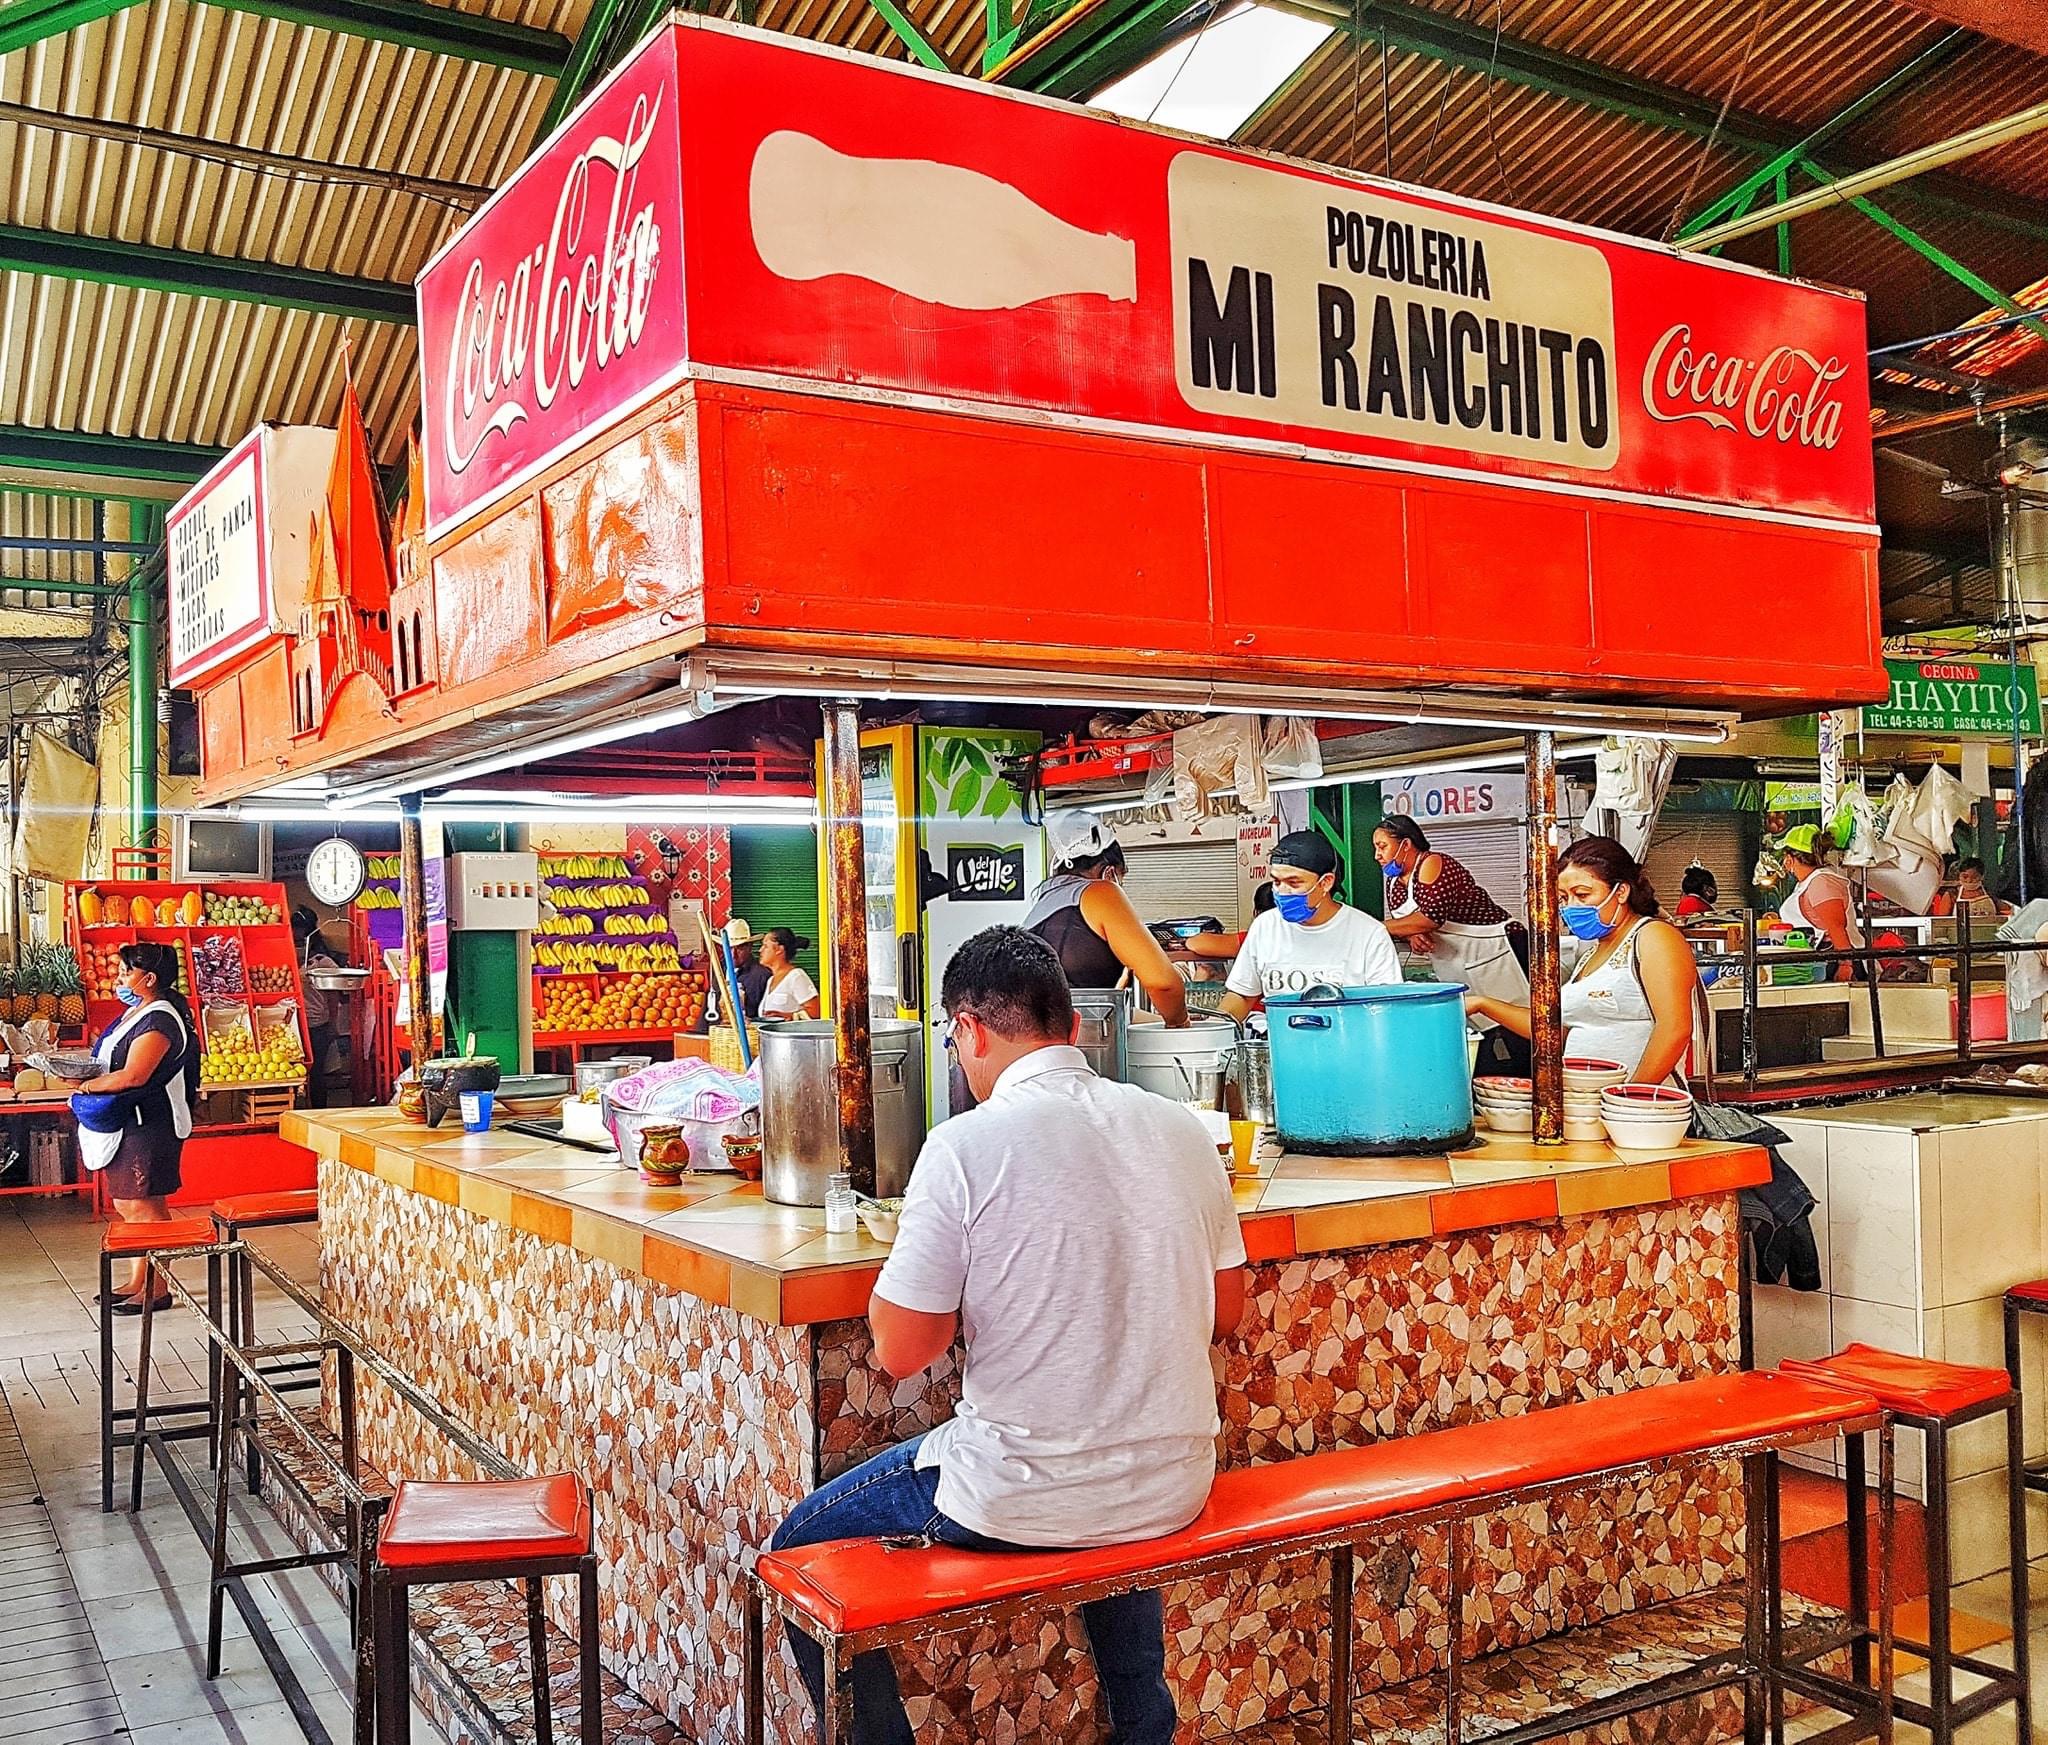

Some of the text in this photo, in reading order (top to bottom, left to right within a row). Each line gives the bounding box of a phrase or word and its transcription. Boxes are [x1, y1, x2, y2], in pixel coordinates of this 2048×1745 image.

[1326, 205, 1491, 301] POZOLERIA
[446, 81, 665, 474] Coca-Cola
[1188, 256, 1608, 450] MI RANCHITO
[1642, 323, 1849, 450] Coca-Cola
[179, 504, 207, 549] POZOLE
[179, 495, 253, 577] MOLE DE PANZA
[180, 553, 220, 602] MIXIOTES
[181, 591, 207, 630] TACOS
[182, 607, 225, 656] TOSTADAS
[1922, 664, 1975, 680] CECINA
[1869, 713, 1888, 728] TEL:
[1889, 715, 1945, 729] 44-5-50-50
[1953, 717, 1979, 730] CASA:
[1382, 783, 1494, 818] COLORES
[1239, 826, 1272, 840] MICHELADA
[1253, 843, 1261, 856] DE
[956, 858, 1014, 892] Valle
[976, 856, 989, 870] del
[1249, 865, 1267, 879] LITRO
